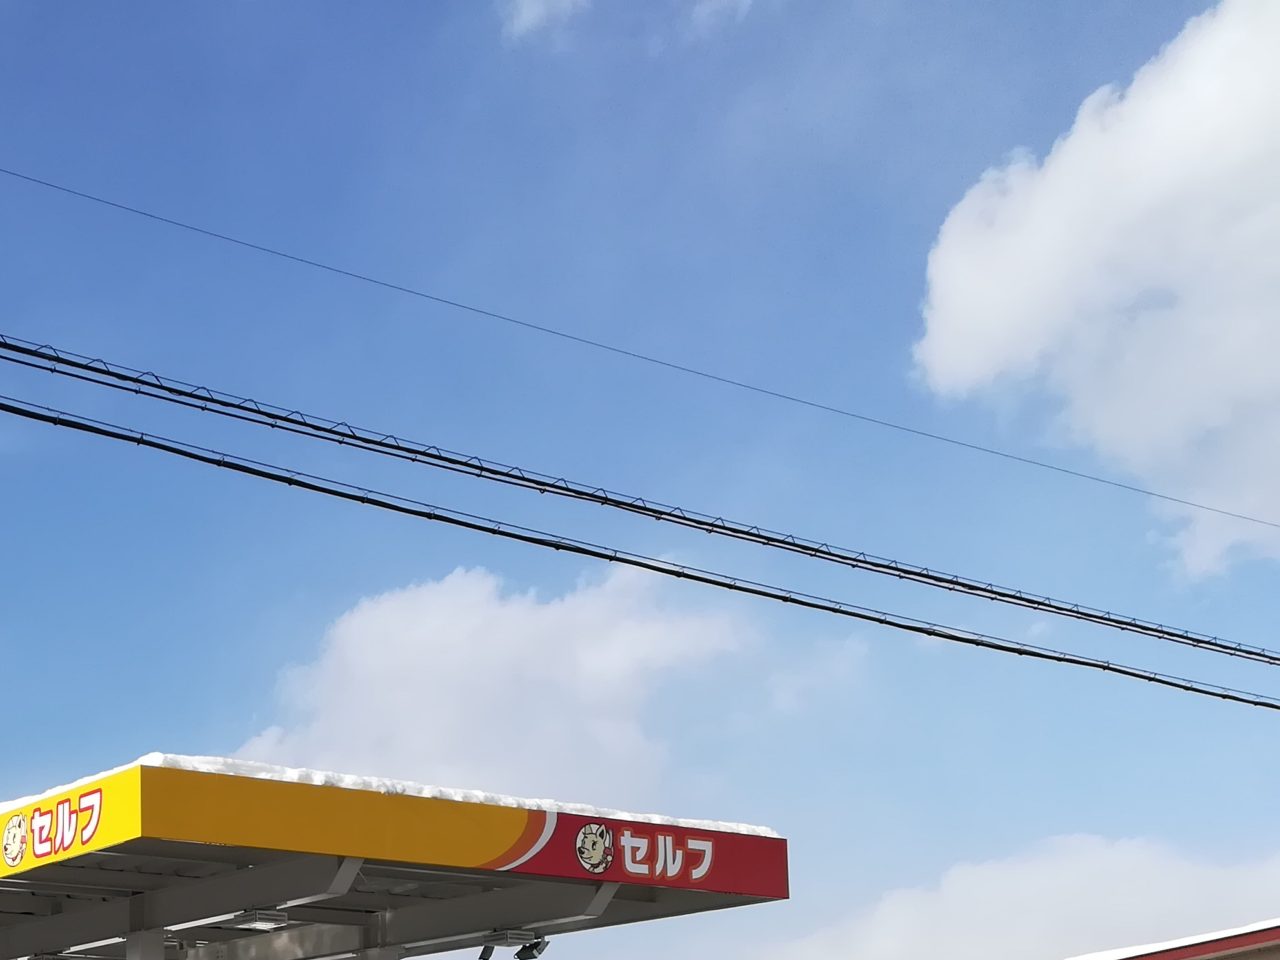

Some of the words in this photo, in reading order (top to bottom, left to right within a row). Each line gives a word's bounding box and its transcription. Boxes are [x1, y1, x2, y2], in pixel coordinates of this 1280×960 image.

[31, 788, 102, 858] セルフ
[620, 830, 713, 880] セルフ
